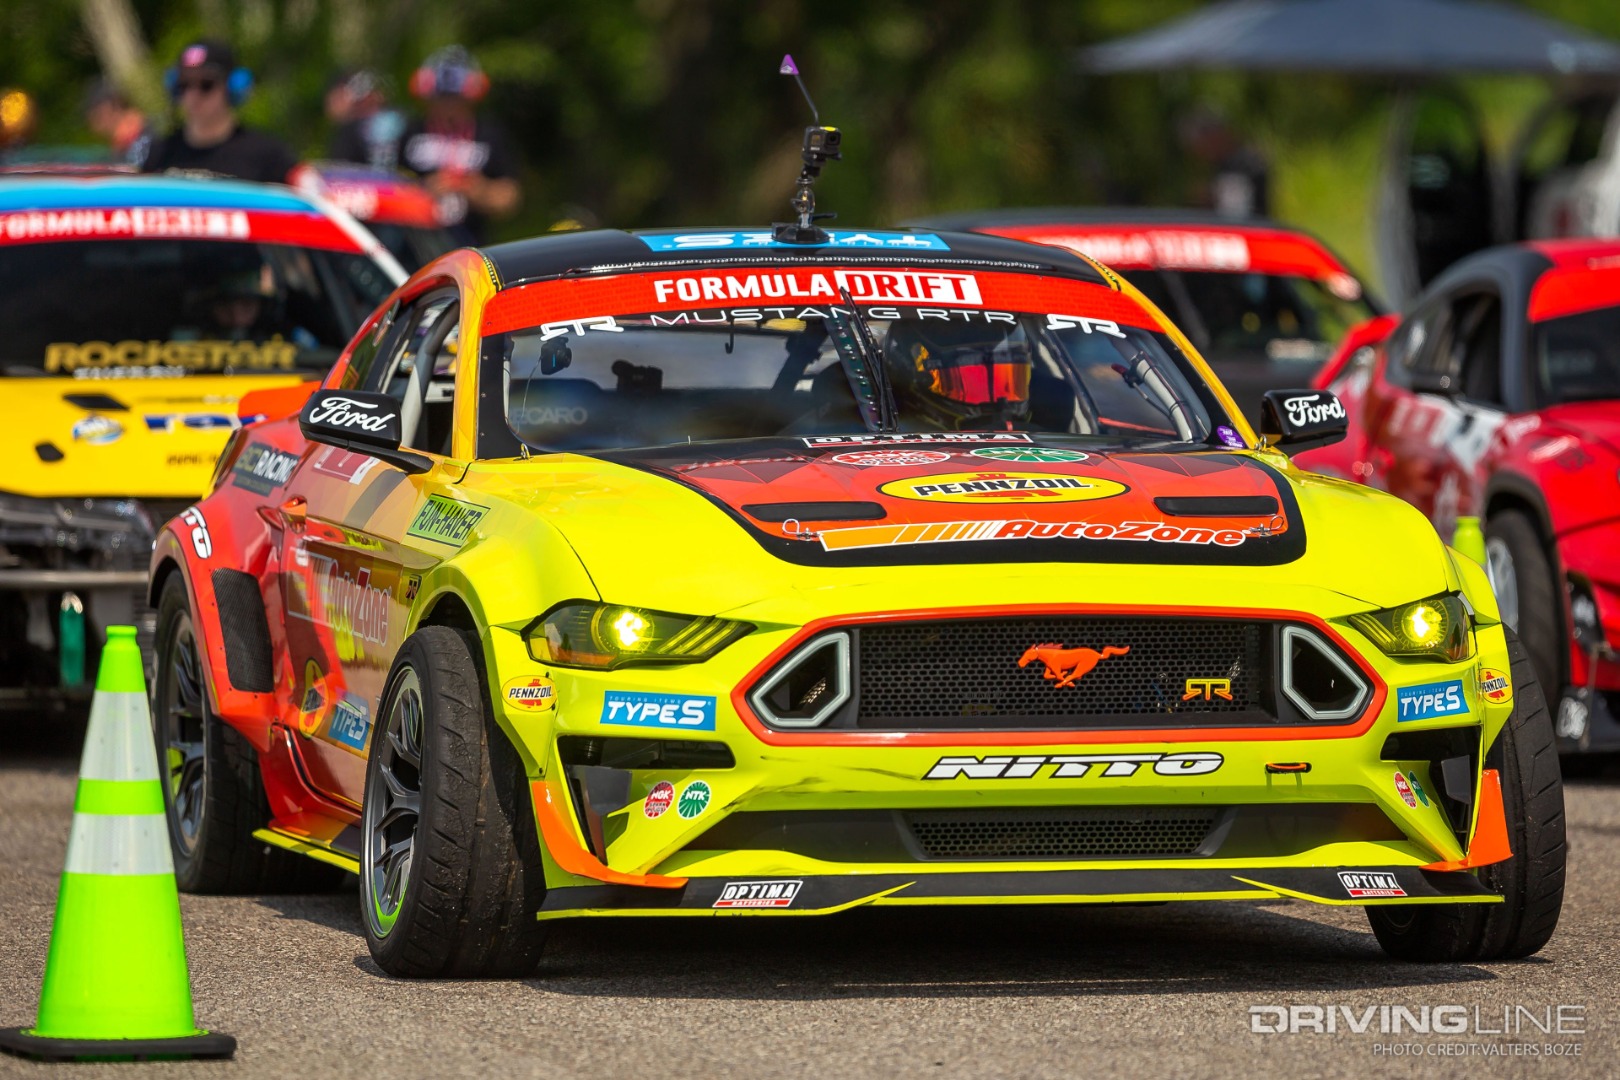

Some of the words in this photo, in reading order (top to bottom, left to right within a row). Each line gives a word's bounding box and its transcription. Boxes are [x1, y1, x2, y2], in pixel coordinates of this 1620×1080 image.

[654, 273, 834, 302] FORMULA
[844, 273, 967, 302] DRIFT
[650, 307, 901, 327] MUSTANG
[916, 308, 1018, 326] RTR
[308, 396, 397, 432] Ford
[1284, 394, 1347, 427] Ford
[814, 433, 1020, 443] OPTIMA
[913, 477, 1092, 497] PENNZOIL
[411, 499, 483, 541] FUN-HAVER
[993, 519, 1246, 547] AutoZone
[508, 686, 554, 699] PENNZOIL
[1481, 676, 1509, 694] PENNZOIL
[921, 752, 1225, 781] NITTO
[651, 789, 672, 800] NGK
[685, 789, 708, 801] NTK
[723, 883, 796, 900] OPTIMA
[1342, 874, 1398, 889] OPTIMA
